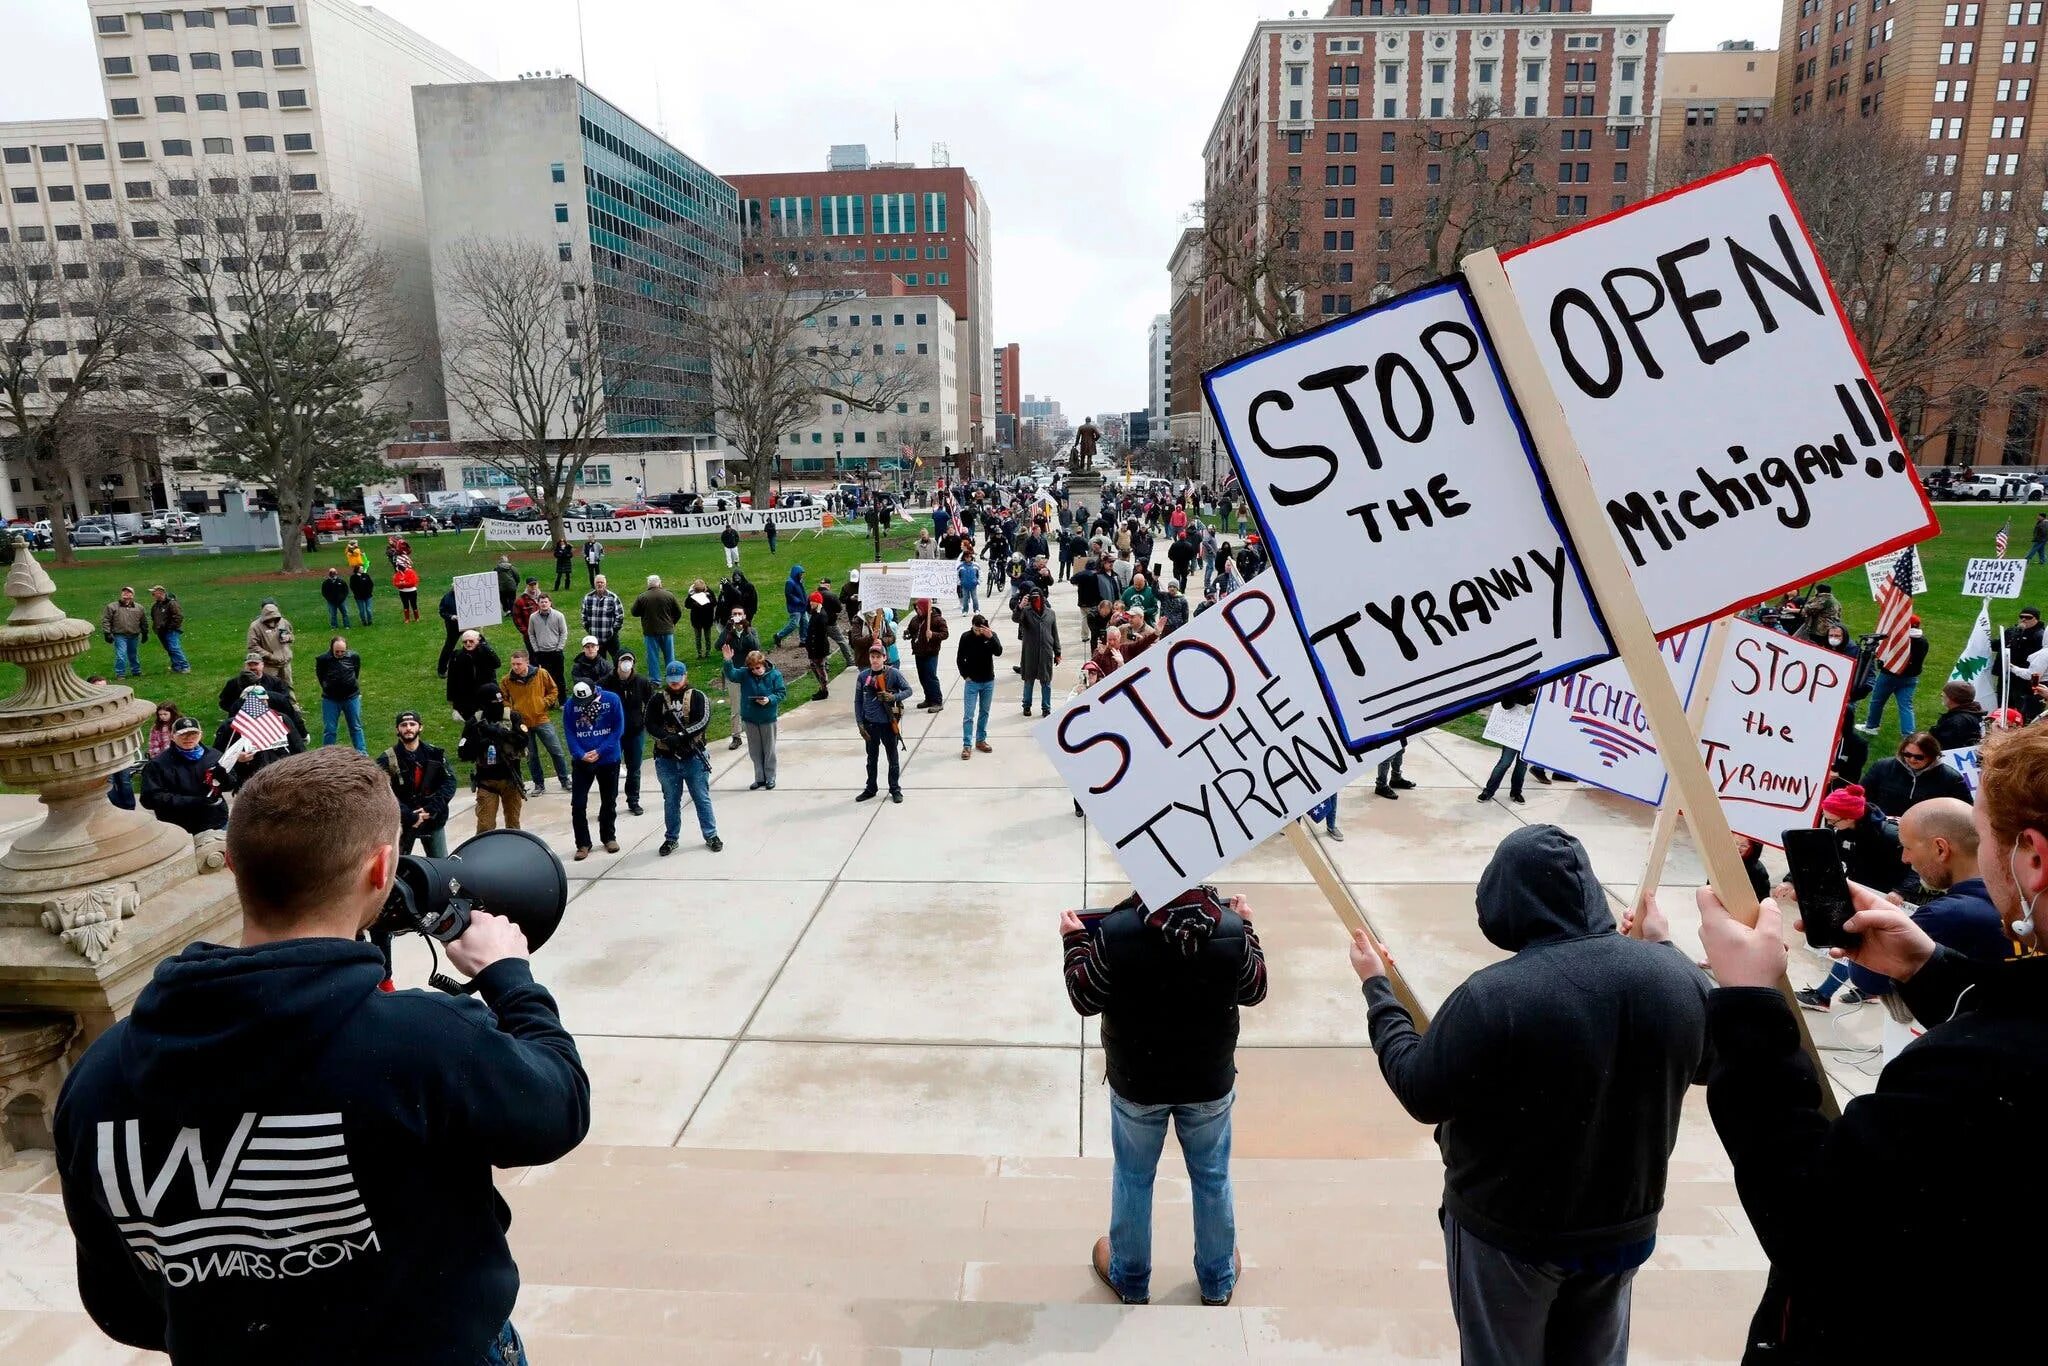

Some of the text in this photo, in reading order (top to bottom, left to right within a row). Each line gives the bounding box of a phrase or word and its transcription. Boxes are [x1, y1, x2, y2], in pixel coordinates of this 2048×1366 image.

[1550, 214, 1825, 399] OPEN
[1249, 321, 1479, 506] STOP
[1346, 473, 1471, 542] THE
[455, 573, 497, 591] RECALL
[1967, 572, 2015, 582] WHITMER
[1970, 583, 2012, 594] REGIME
[1971, 560, 2014, 571] REMOVE
[1309, 547, 1565, 676] TYRANNY
[1057, 589, 1276, 795] STOP
[1732, 638, 1839, 702] STOP
[1177, 675, 1304, 774] THE
[1549, 672, 1652, 733] MICHIG
[1742, 710, 1794, 743] the
[1115, 717, 1360, 878] TYRAN
[133, 1230, 382, 1288] INOWARS.COM
